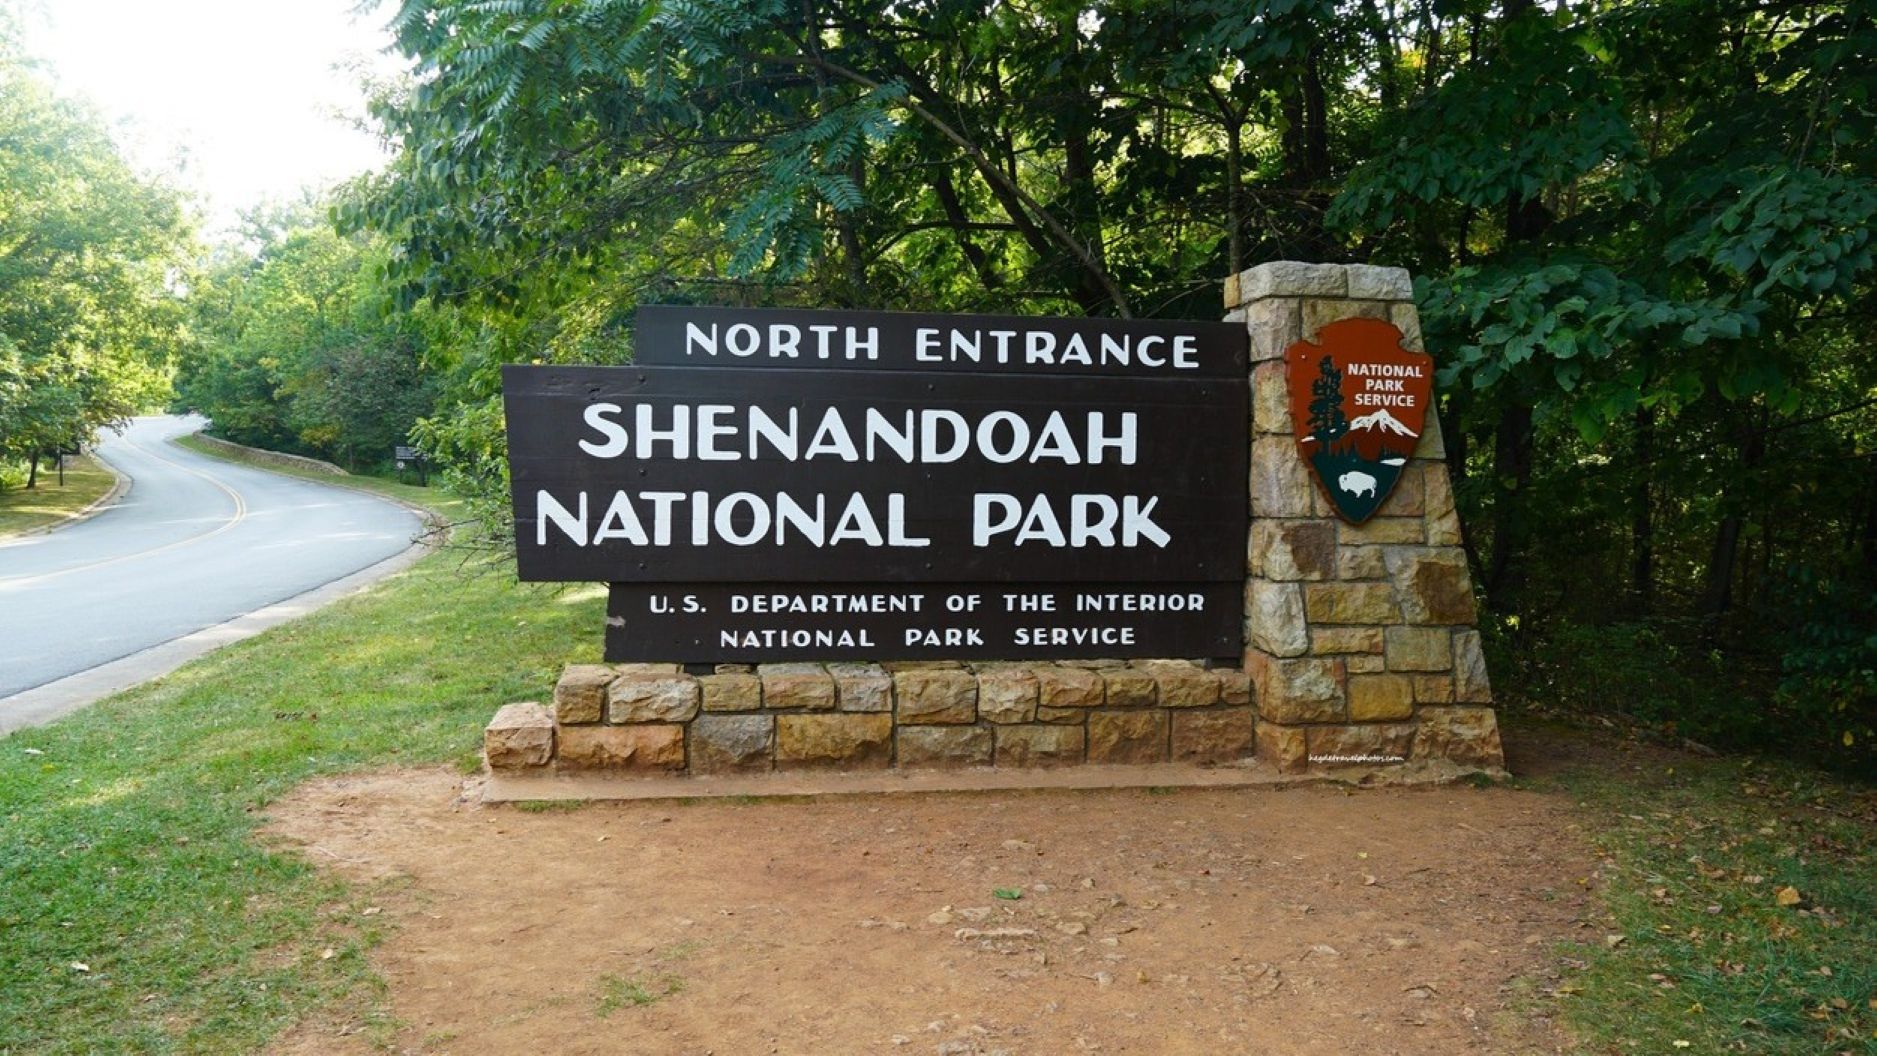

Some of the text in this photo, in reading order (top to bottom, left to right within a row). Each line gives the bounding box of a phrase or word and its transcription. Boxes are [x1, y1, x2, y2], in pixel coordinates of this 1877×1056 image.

[686, 322, 1199, 368] NORTH ENTRANCE
[1348, 364, 1423, 377] NATIONAL
[1365, 379, 1404, 391] PARK
[1355, 393, 1415, 406] SERVICE
[578, 402, 1138, 465] SHENANDOAH
[537, 489, 1171, 548] NATIONAL PARK
[650, 593, 1205, 613] U.S. DEPARTMENT OF THE INTERIOR
[720, 627, 1135, 648] NATIONAL PARK SERVICE
